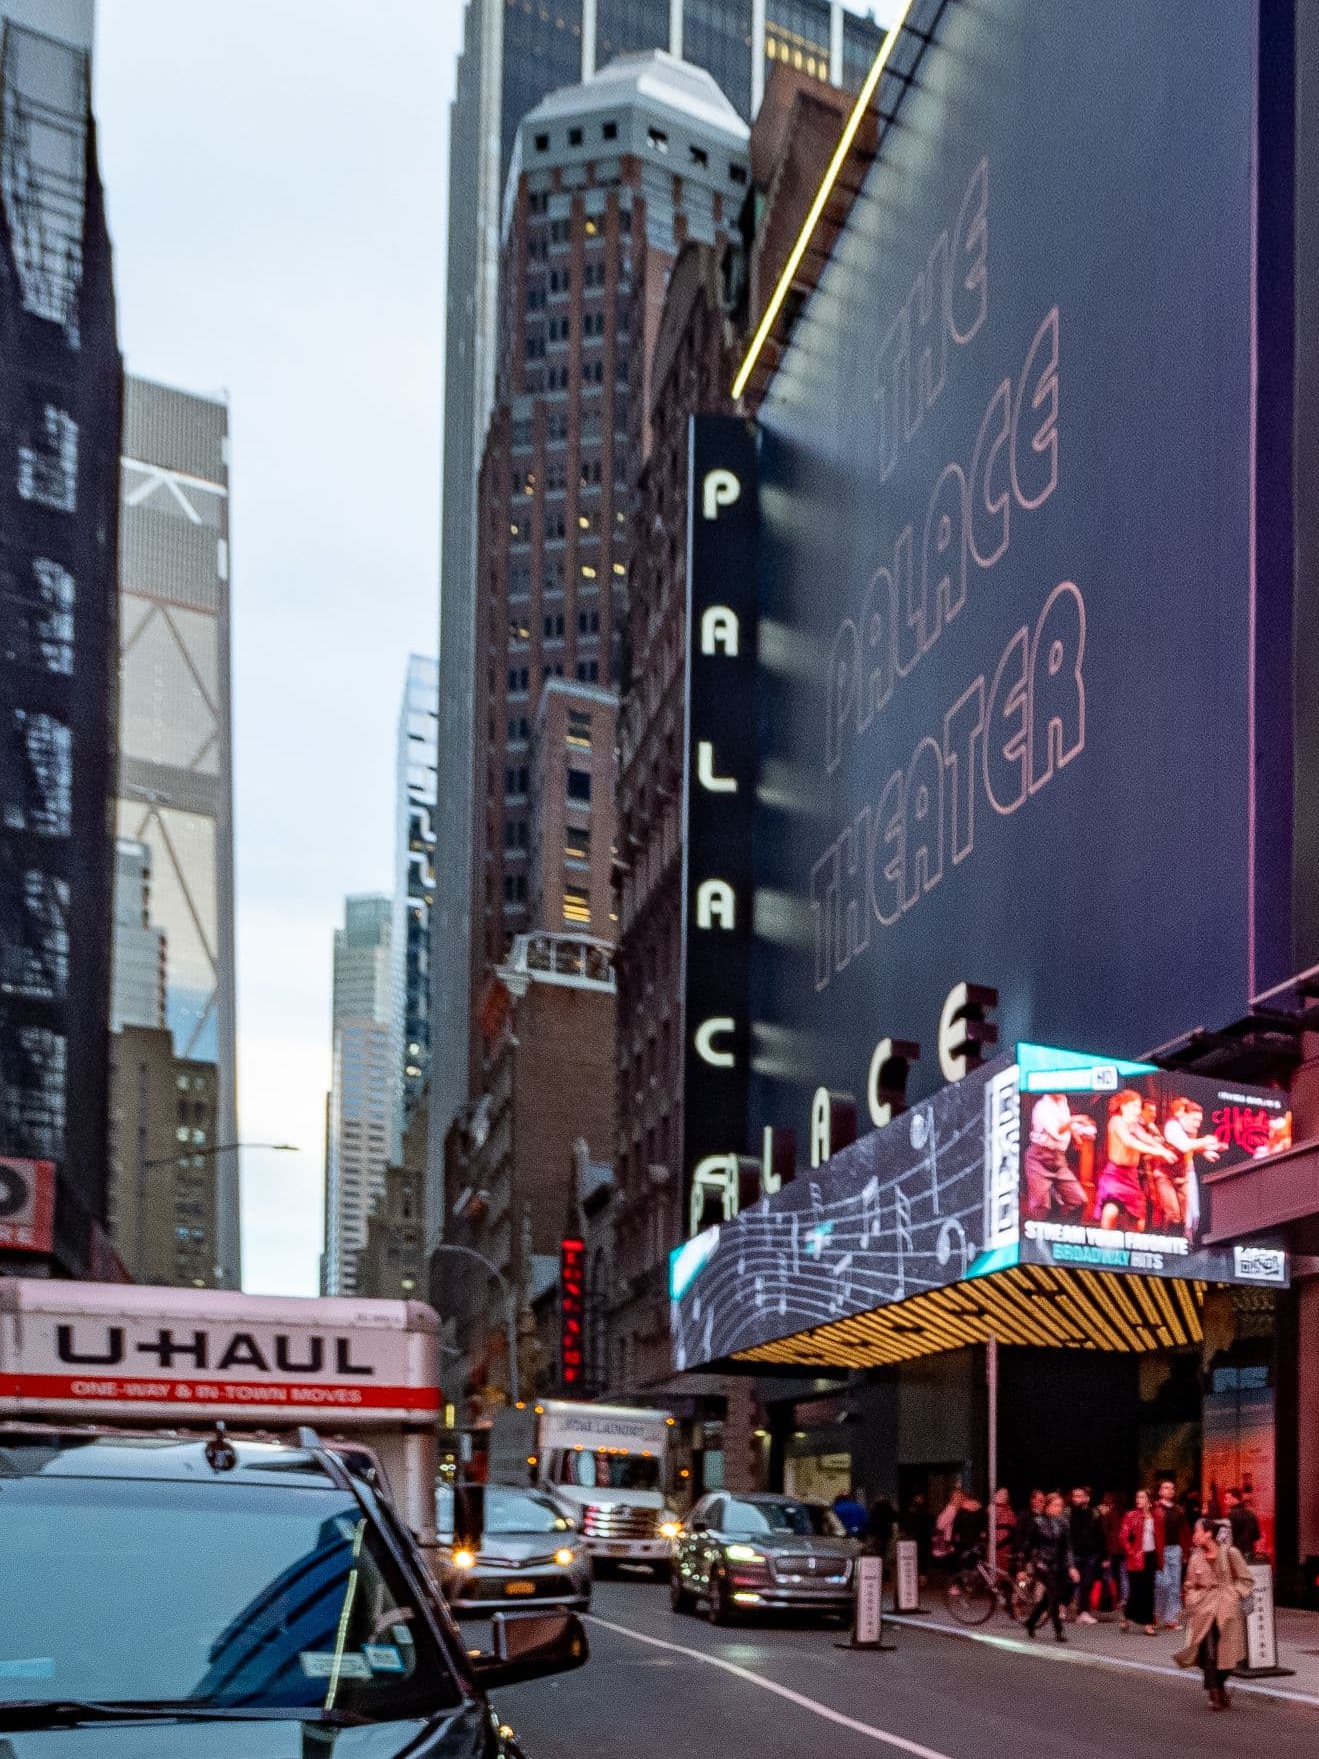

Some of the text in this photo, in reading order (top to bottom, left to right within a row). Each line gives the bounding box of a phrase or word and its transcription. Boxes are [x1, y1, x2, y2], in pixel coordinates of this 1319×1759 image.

[875, 156, 989, 484] THE
[824, 306, 1060, 774] PALACE
[808, 581, 1086, 992] THEATER
[57, 1325, 374, 1376] U-HAUL
[70, 1379, 363, 1405] ONE-WAY & IN-TOWN MOVES
